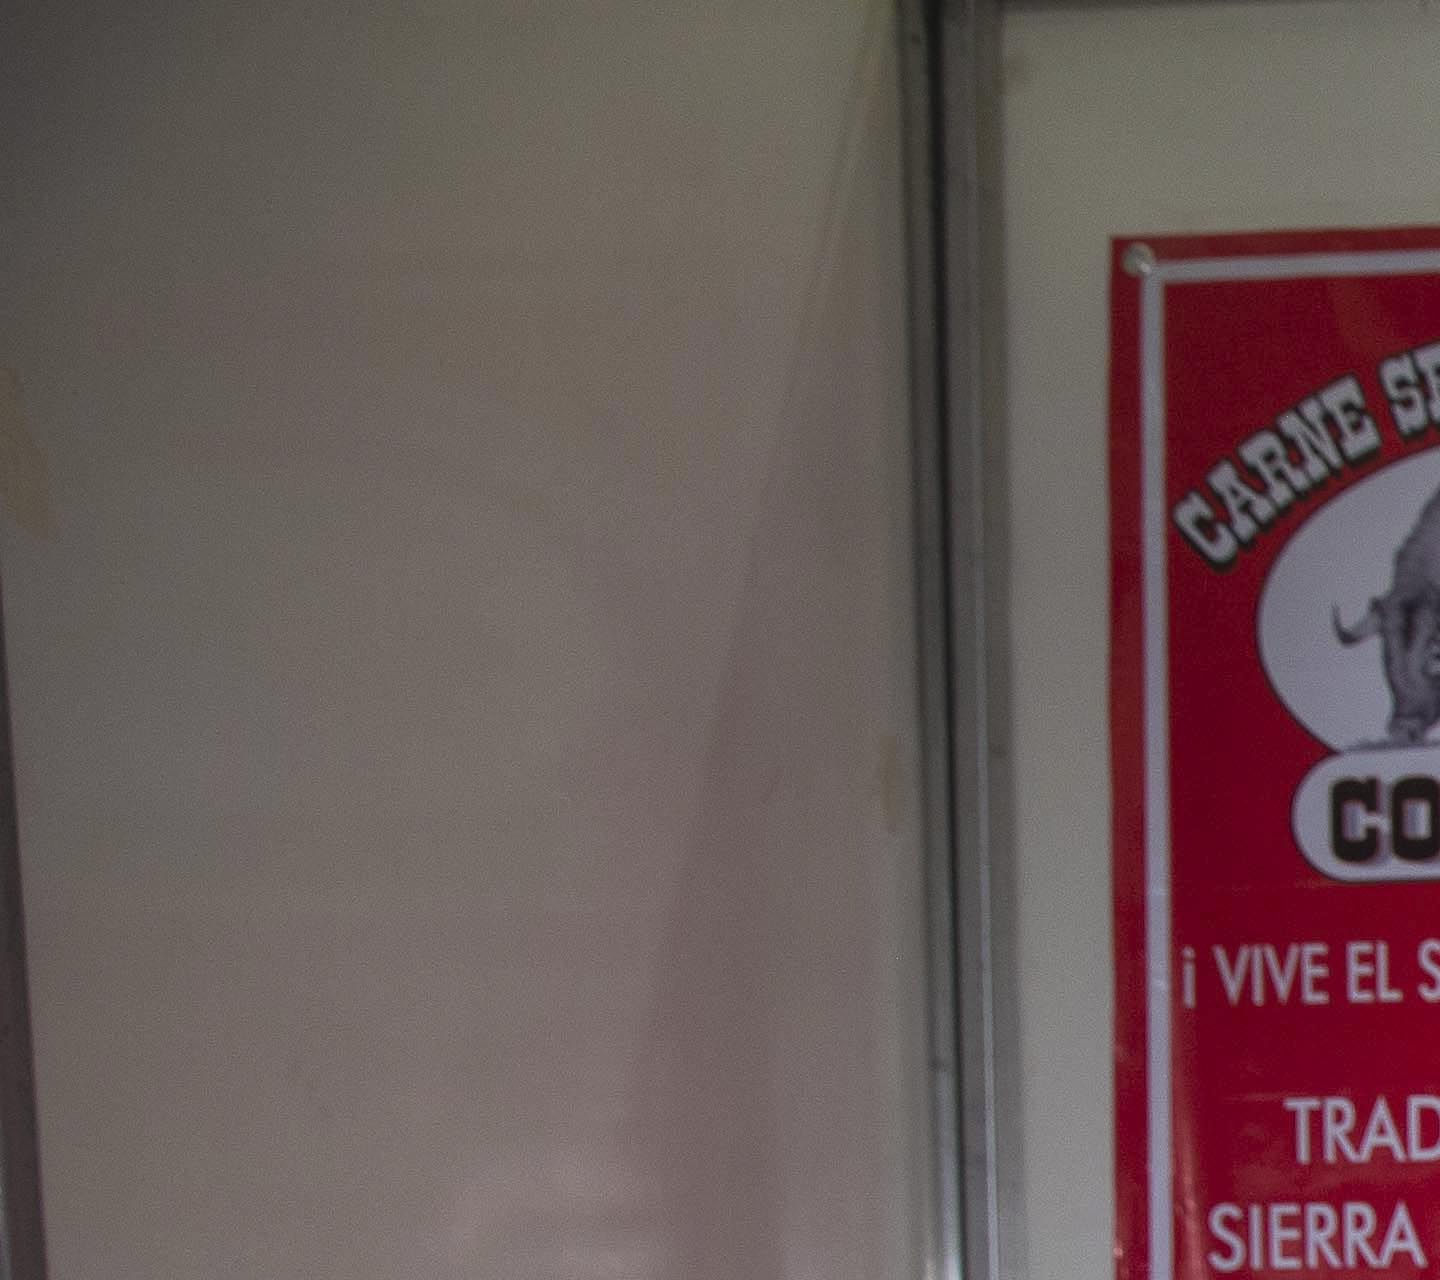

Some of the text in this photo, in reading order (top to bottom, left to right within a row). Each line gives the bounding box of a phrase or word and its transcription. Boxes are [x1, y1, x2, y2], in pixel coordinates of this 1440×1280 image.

[1173, 376, 1380, 566] CARNE
[1214, 942, 1329, 1006] VIVE
[1347, 941, 1403, 1003] EL
[1209, 1202, 1427, 1272] SIERRA
